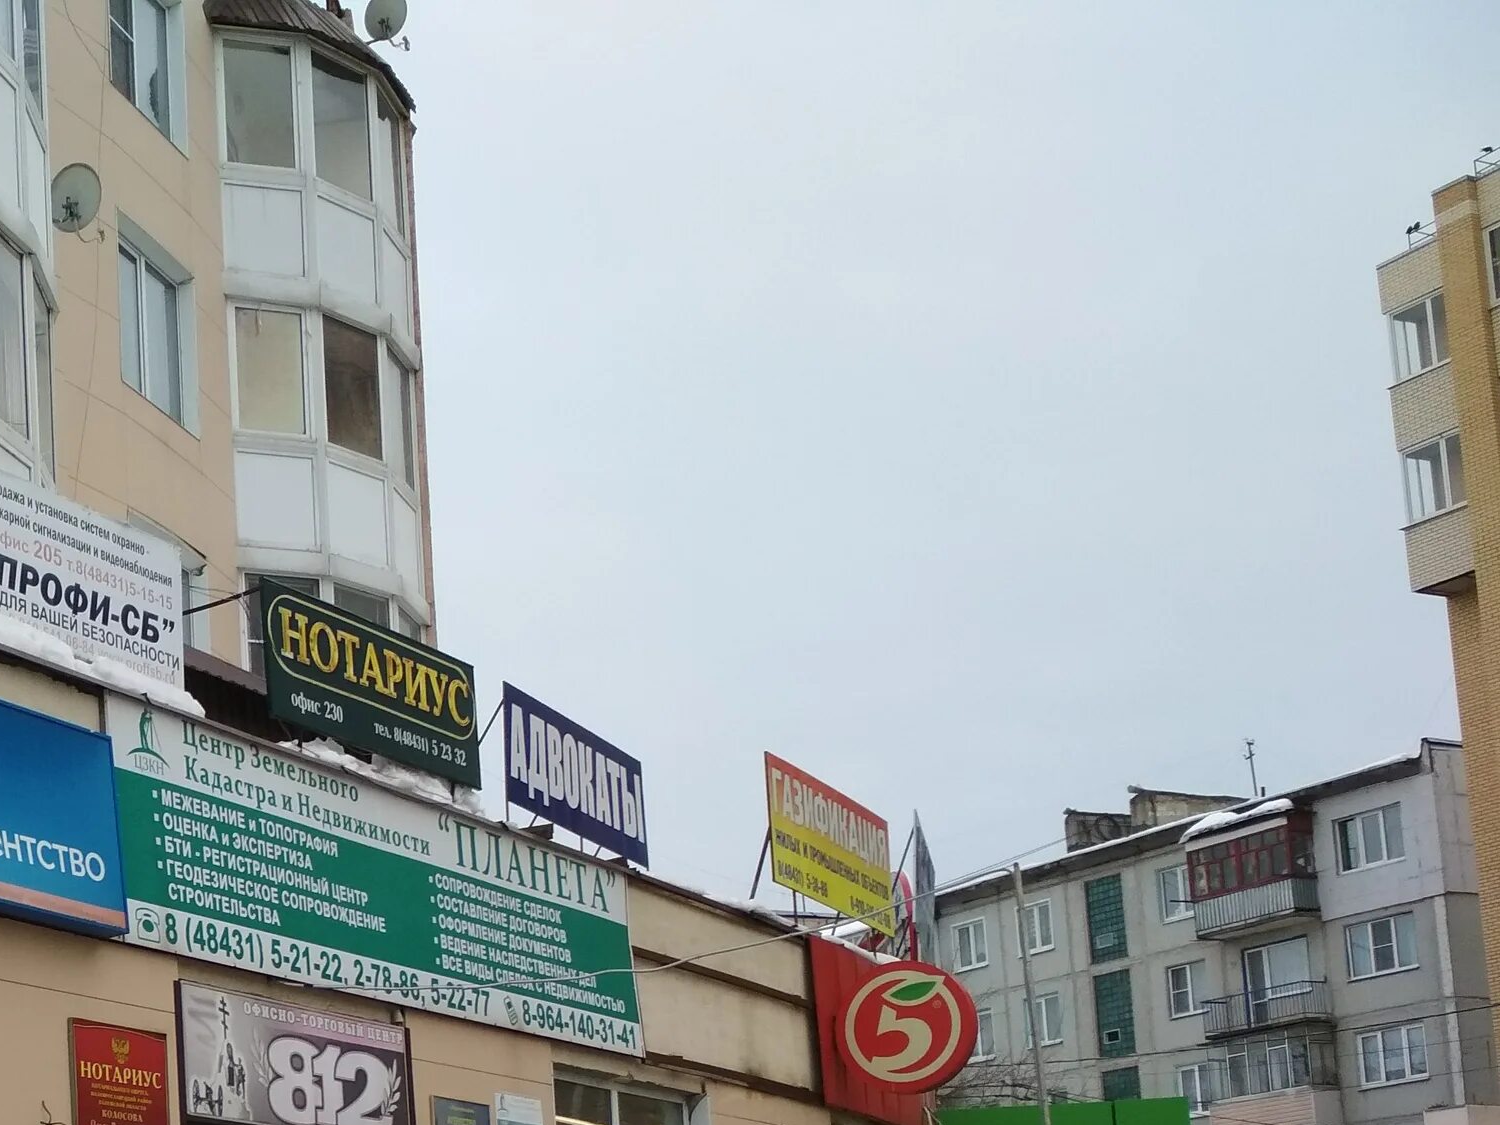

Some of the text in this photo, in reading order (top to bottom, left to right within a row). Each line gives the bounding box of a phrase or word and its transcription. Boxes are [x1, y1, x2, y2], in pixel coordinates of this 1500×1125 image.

[27, 498, 33, 509] и
[35, 500, 79, 529] установка
[80, 519, 110, 541] систем
[111, 531, 145, 557] охранно
[32, 520, 92, 557] сигнализации
[94, 545, 99, 557] и
[101, 548, 173, 588] видеонаблюдения
[33, 541, 63, 567] 205
[31, 602, 79, 633] ВАШЕЙ
[82, 621, 180, 671] БЕЗОПАСНОСТИ
[278, 606, 470, 727] НОТАРИУС
[291, 692, 343, 723] офис 230
[134, 753, 165, 776] ЦЗКН
[181, 720, 359, 802] Центр Земельного
[374, 722, 467, 766] тел. 8(48431) 5 23 32
[510, 703, 645, 844] АДВОКАТЫ
[161, 788, 339, 857] МЕЖЕВАНИЕ и ТОПОГРАФИЯ
[184, 754, 431, 857] Кадастра и Недвижимости
[771, 767, 888, 871] ГАЗИФИКАЦИЯ
[163, 812, 313, 871] ОЦЕНКА и ЭКСПЕРТИЗА
[164, 837, 192, 859] БТИ
[203, 846, 329, 895] РЕГИСТРАЦИОННЫЙ
[331, 883, 368, 907] ЦЕНТР
[167, 860, 387, 934] ГЕОДЕЗИЧЕСКОЕ СОПРОВОЖДЕНИЕ
[435, 873, 562, 925] СОПРОВОЖДЕНИЕ СДЕЛОК
[168, 884, 281, 928] СТРОИТЕЛЬСТВА
[437, 894, 567, 943] СОСТАВЛЕНИЕ ДОГОВОРОВ
[438, 914, 572, 963] ОФОРМЛЕНИЕ ДОКУМЕНТОВ
[440, 934, 597, 988] ВЕДЕНИЕ НАСЛЕДСТВЕННЫХ ДЕЛ
[165, 913, 177, 945] 8
[185, 917, 264, 969] (48431)
[271, 938, 348, 985] 5-21-22,
[430, 977, 490, 1017] 5-22-77
[522, 999, 636, 1049] 8-964-140-31-41
[442, 954, 463, 973] ВСЕ
[465, 959, 494, 981] ВИДЫ
[544, 981, 626, 1013] НЕДВИЖИМОСТЬЮ
[244, 1001, 403, 1045] ОФИСНО-ТОРГОВЫЙ ЦЕНТР
[80, 1061, 162, 1089] НОТАРИУС
[102, 1109, 143, 1122] КОЛОСОВА
